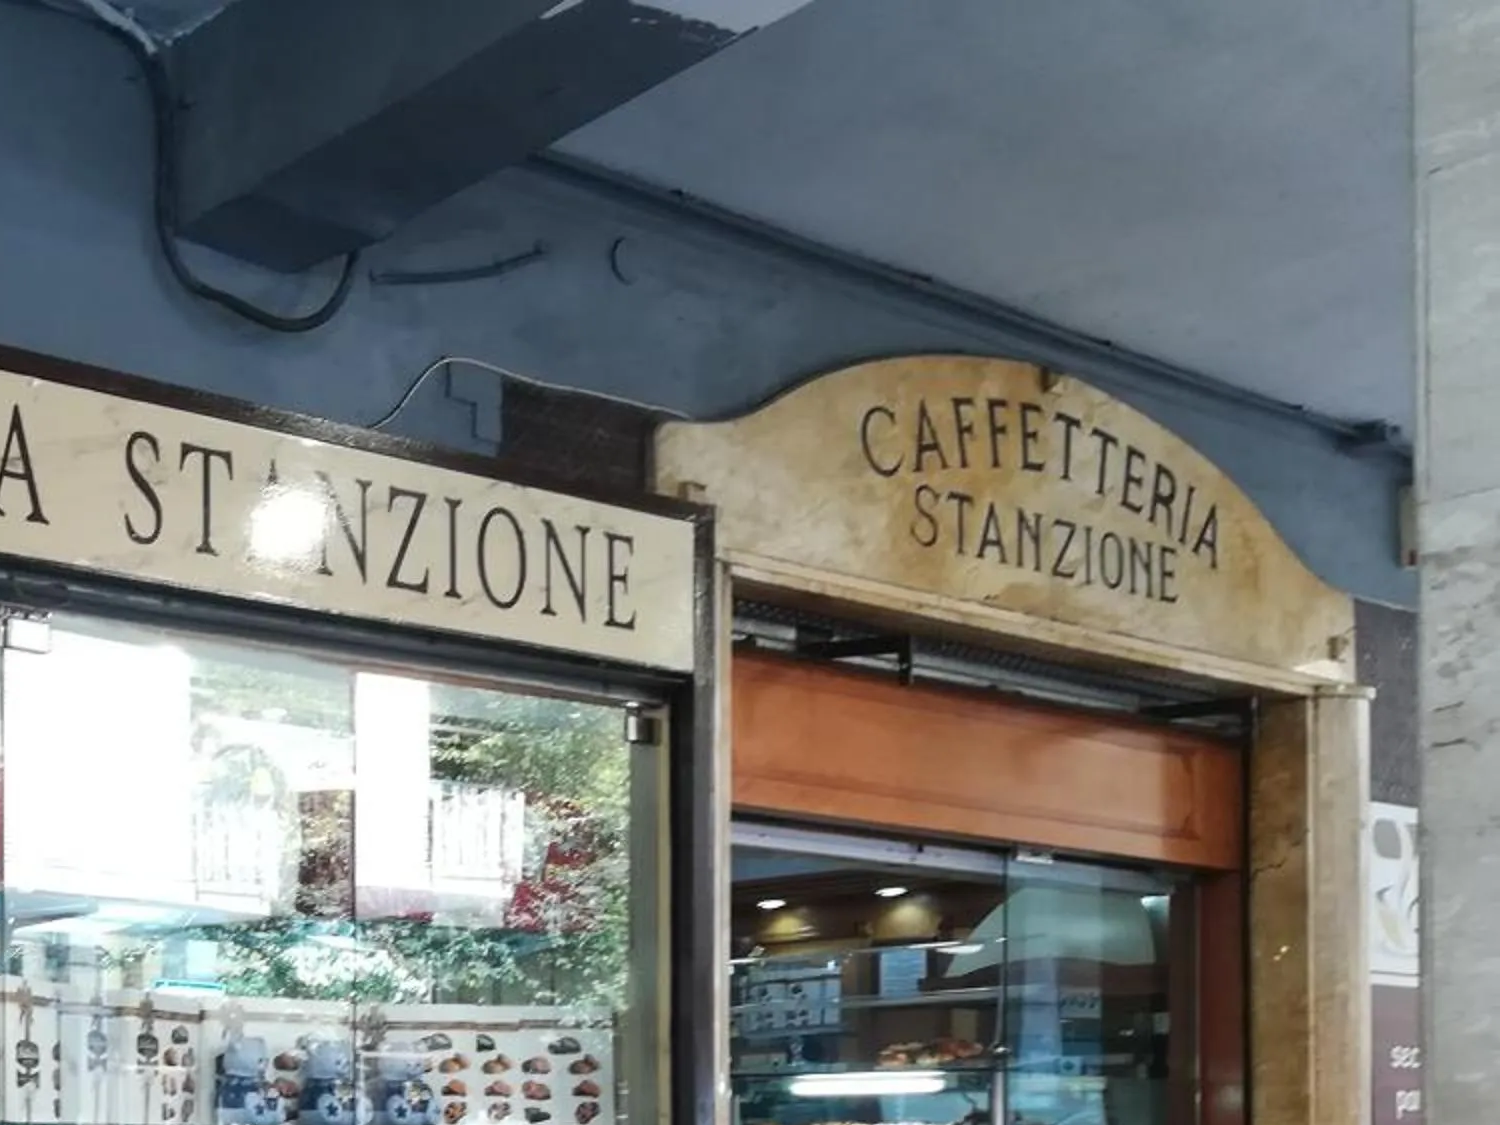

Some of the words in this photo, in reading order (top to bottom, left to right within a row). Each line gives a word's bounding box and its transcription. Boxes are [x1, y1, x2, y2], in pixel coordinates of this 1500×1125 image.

[123, 430, 636, 630] STNZIONE
[860, 397, 1220, 570] CAFFETTERIA
[911, 484, 1180, 604] STANZIONE
